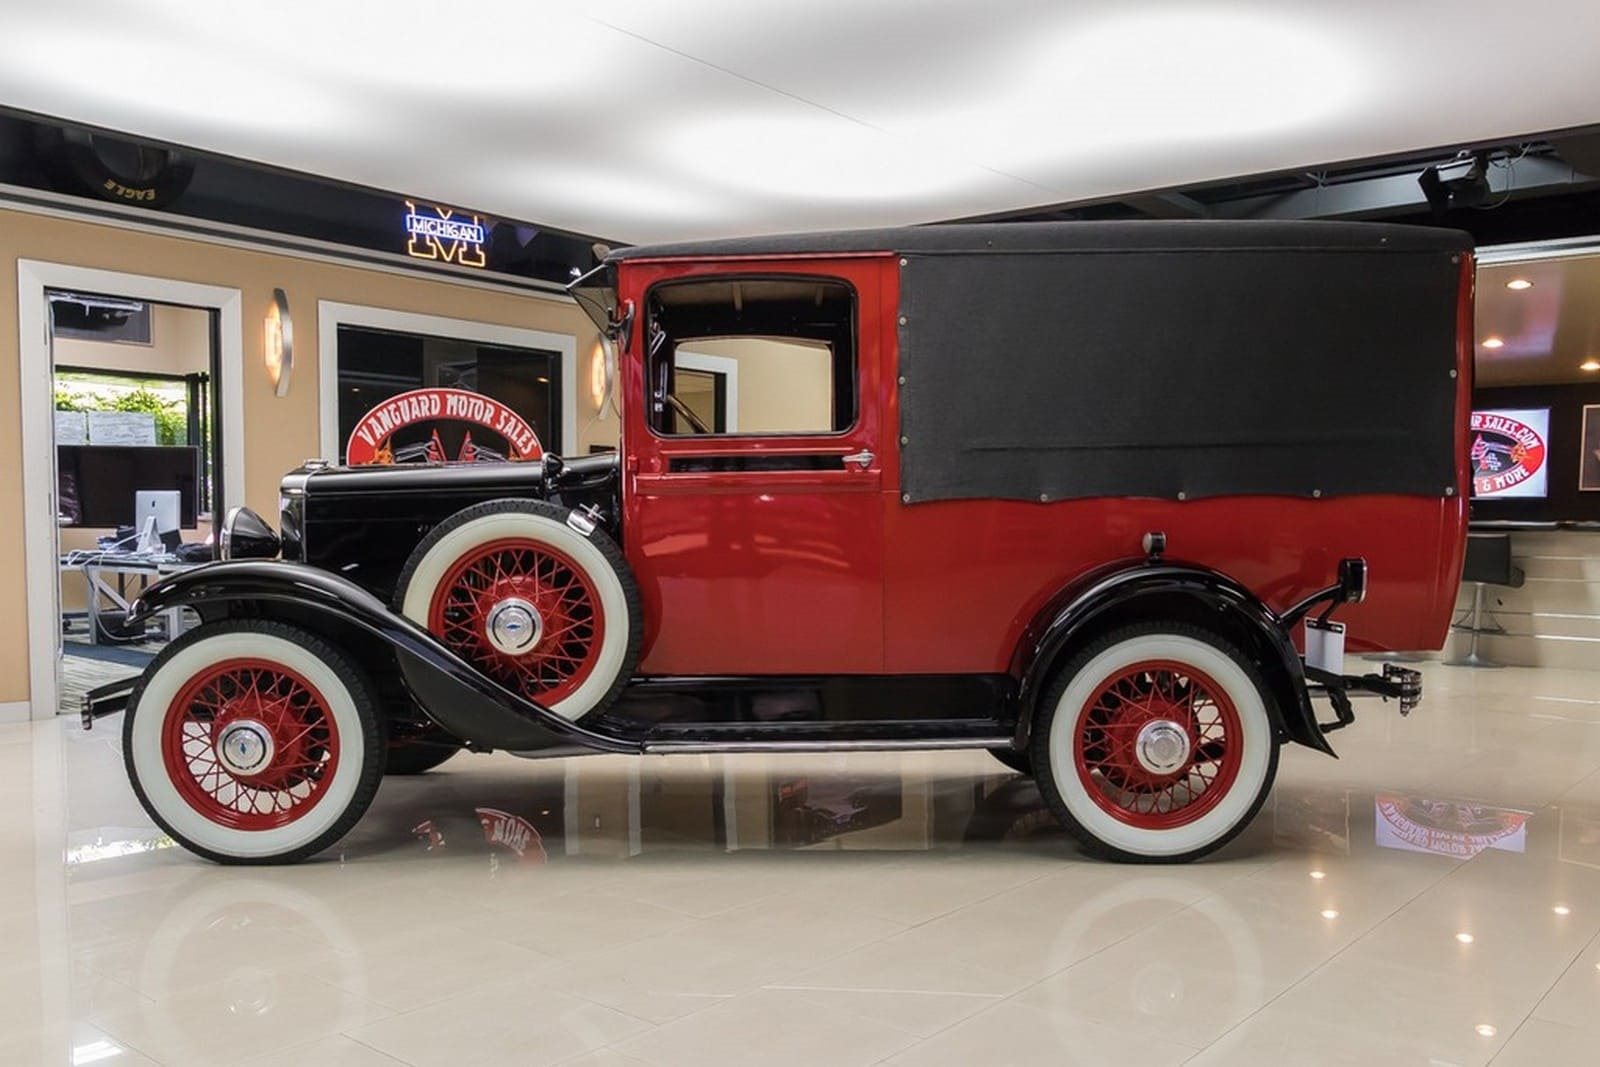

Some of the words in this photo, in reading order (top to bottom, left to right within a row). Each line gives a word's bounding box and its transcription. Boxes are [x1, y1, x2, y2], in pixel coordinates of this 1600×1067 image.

[103, 179, 156, 200] EAGLE
[413, 218, 478, 241] MICHIGAN
[357, 393, 441, 447] VANGUARD
[446, 393, 495, 426] MOTOR
[495, 410, 538, 455] SALES
